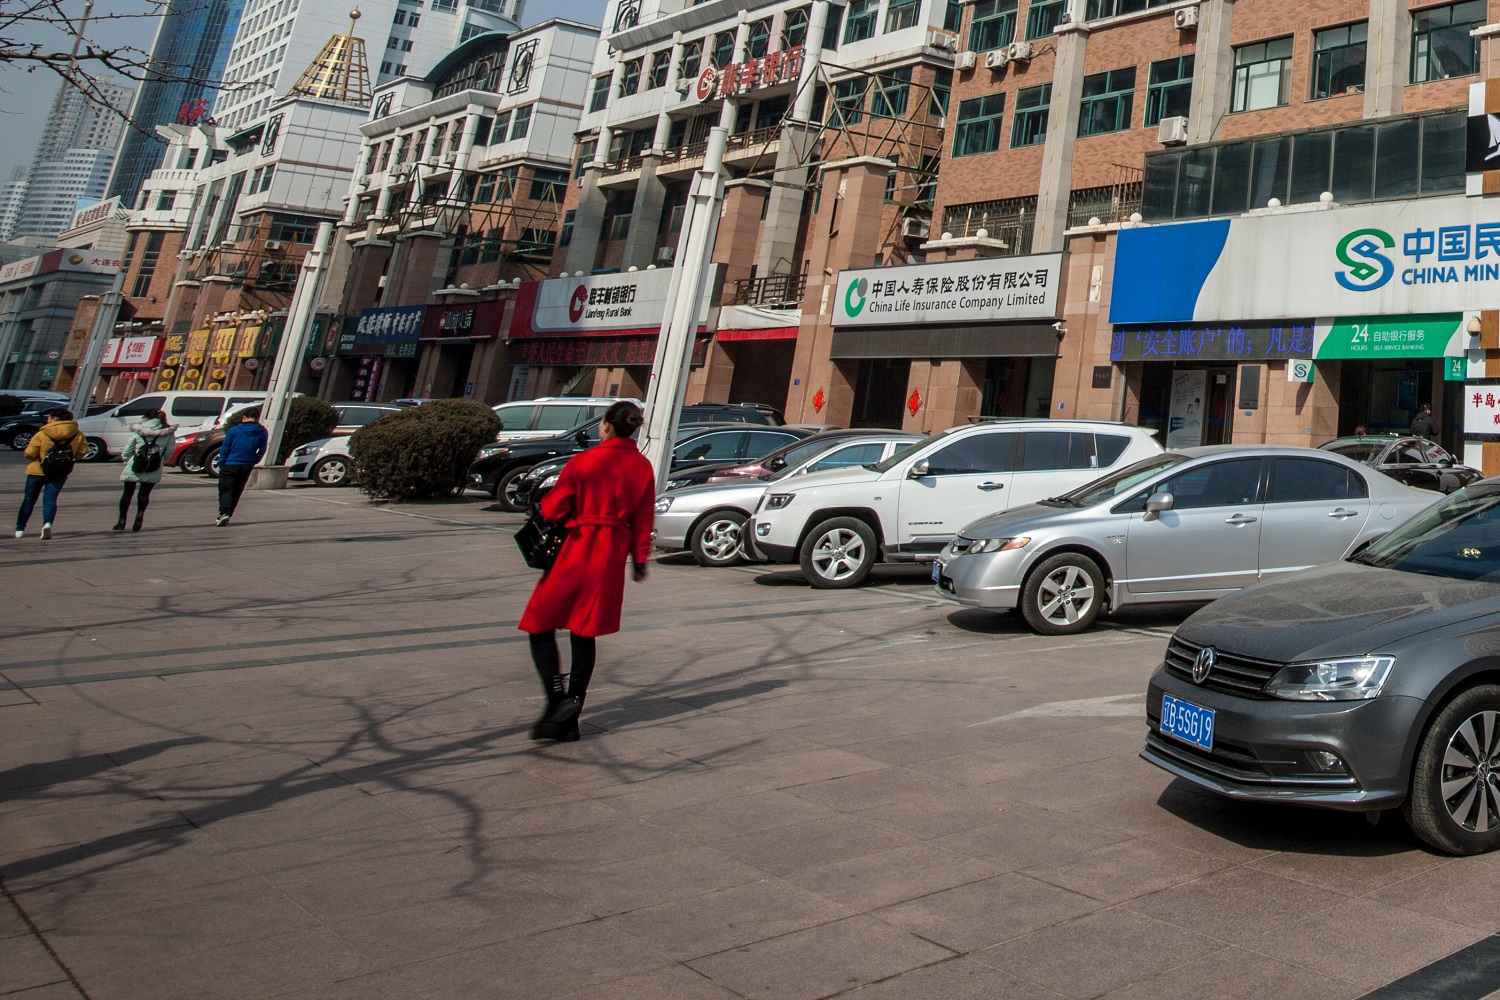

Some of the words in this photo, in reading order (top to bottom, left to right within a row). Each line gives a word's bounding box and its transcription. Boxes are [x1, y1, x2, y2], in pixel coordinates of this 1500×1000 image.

[721, 44, 805, 95] 联丰银行
[871, 268, 1049, 297] 中国人寿保险股份有限公司
[1401, 263, 1459, 287] CHINA
[588, 284, 638, 306] 联丰村镇银行
[869, 300, 892, 314] China
[895, 299, 911, 313] Life
[913, 297, 956, 312] Insurance
[959, 295, 1003, 312] Company
[1006, 292, 1046, 308] Limited
[585, 308, 605, 320] Lianfeng
[605, 307, 620, 318] Rural
[620, 306, 633, 317] Bank
[1351, 324, 1369, 343] 24
[1373, 330, 1426, 343] 自助银行服务
[1451, 360, 1462, 372] 24
